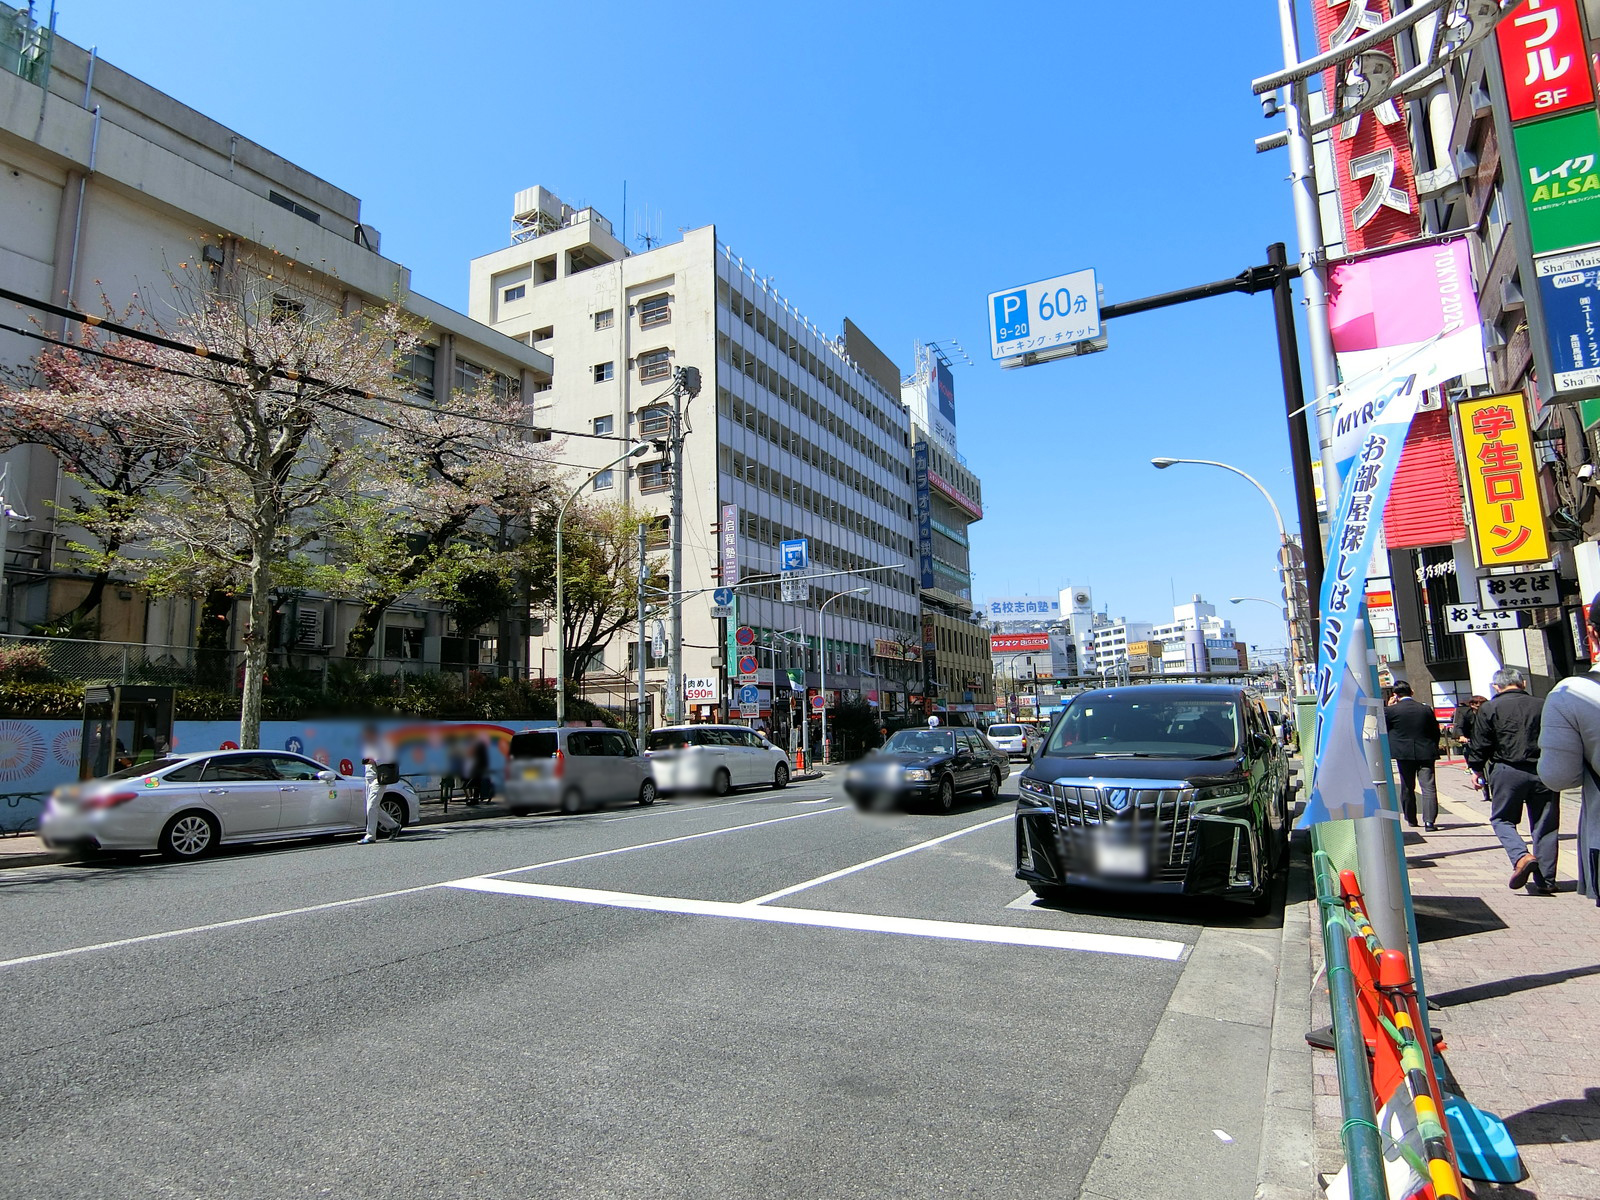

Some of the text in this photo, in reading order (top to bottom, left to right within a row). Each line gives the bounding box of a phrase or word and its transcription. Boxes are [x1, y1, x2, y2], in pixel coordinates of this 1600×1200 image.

[1513, 0, 1571, 86] フル
[1533, 88, 1568, 108] 3F
[1529, 154, 1595, 185] レイク
[1531, 174, 1600, 203] ALSA
[1433, 248, 1460, 294] TOKYO
[1003, 296, 1021, 324] P
[1039, 288, 1088, 321] 60分
[996, 325, 1096, 355] パーキング・チケット
[1000, 323, 1028, 340] 9-20
[1472, 404, 1531, 557] 学生ローン
[1487, 575, 1550, 595] おそば
[991, 601, 1049, 614] 名校志向塾
[992, 639, 1019, 648] カラオケ
[687, 679, 713, 689] 肉めし
[687, 688, 713, 699] 590円
